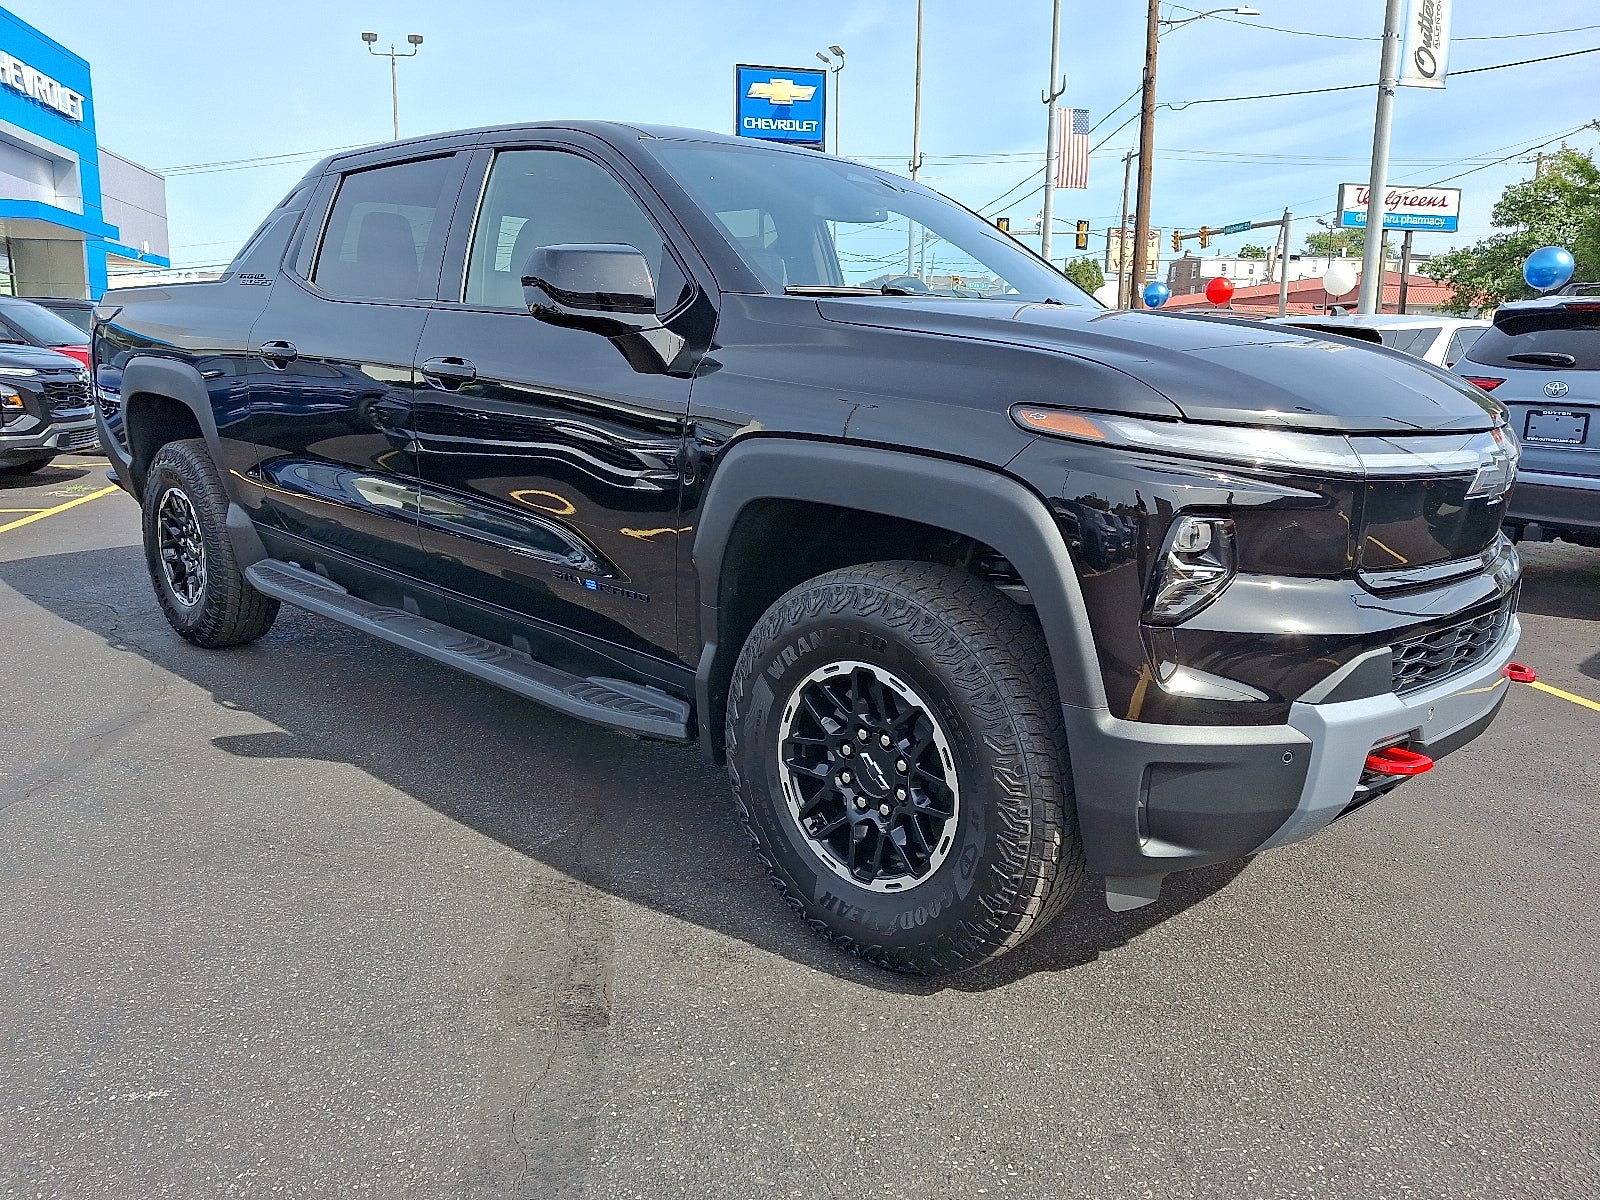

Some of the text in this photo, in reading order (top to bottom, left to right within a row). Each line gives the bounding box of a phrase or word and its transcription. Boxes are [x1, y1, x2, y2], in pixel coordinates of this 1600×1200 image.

[1434, 0, 1442, 50] ALLENTO
[0, 50, 85, 122] HEVROLET
[743, 117, 819, 132] CHEVROLET
[1356, 186, 1449, 212] Wlgreens
[1400, 215, 1446, 227] pharmacy
[766, 626, 889, 680] WRANGLER
